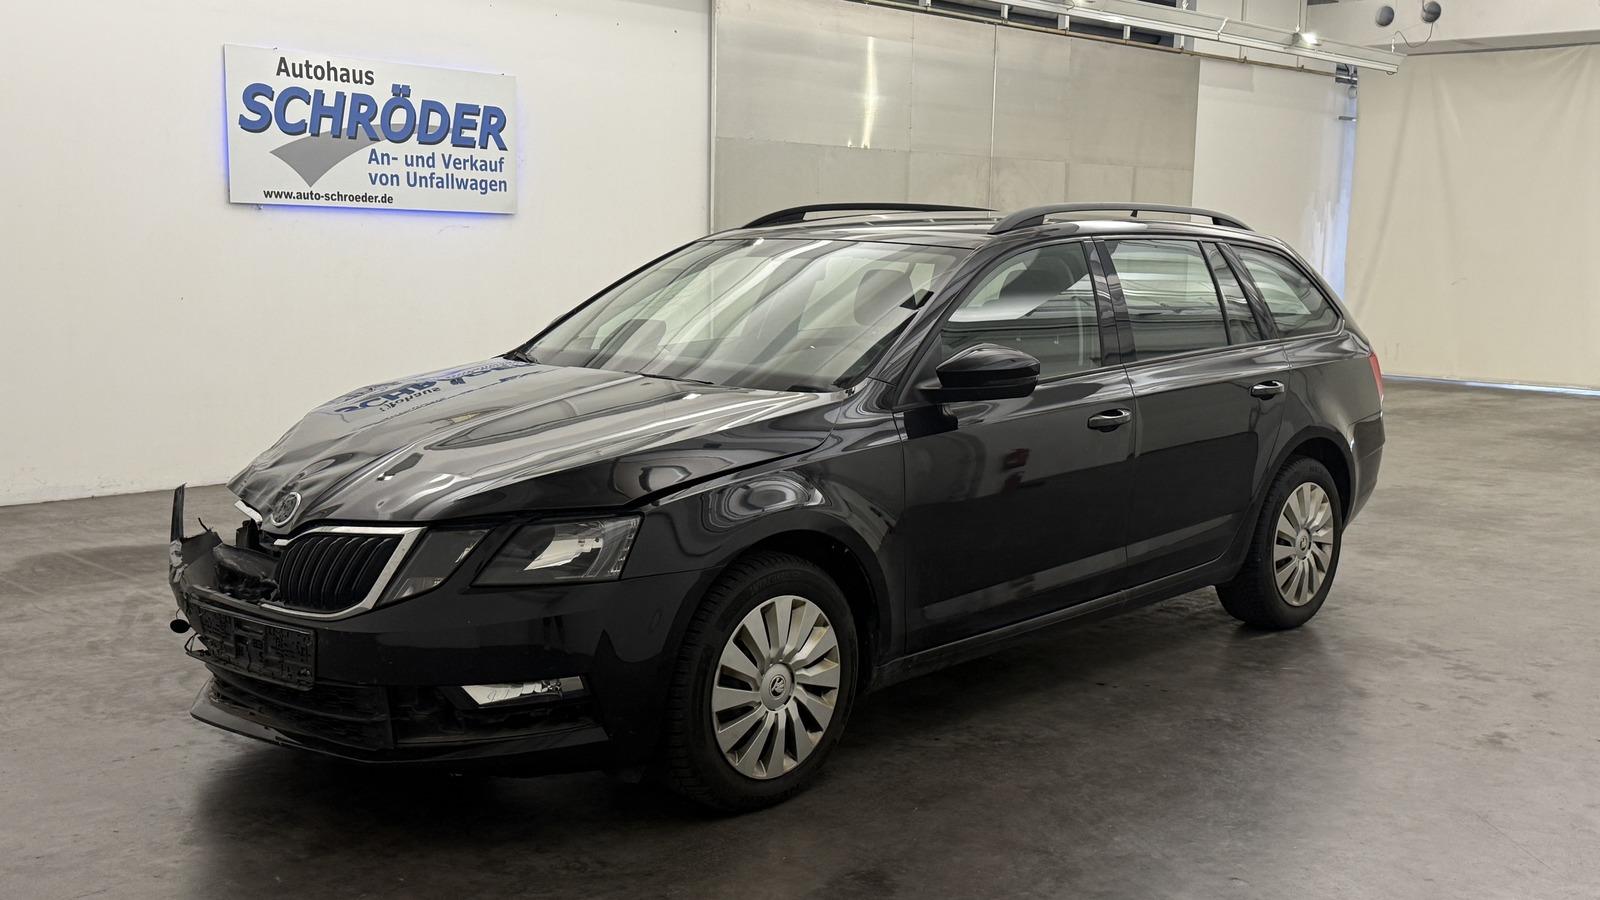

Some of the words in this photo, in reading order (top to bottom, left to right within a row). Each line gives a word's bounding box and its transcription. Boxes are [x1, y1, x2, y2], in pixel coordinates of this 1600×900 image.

[276, 56, 375, 86] Autohaus
[238, 83, 508, 151] SCHRÖDER
[368, 148, 398, 165] An-
[404, 152, 435, 168] und
[441, 153, 505, 172] Verkauf
[368, 172, 400, 186] von
[406, 171, 507, 194] Unfallwagen
[263, 189, 394, 204] www.auto-schroeder.de
